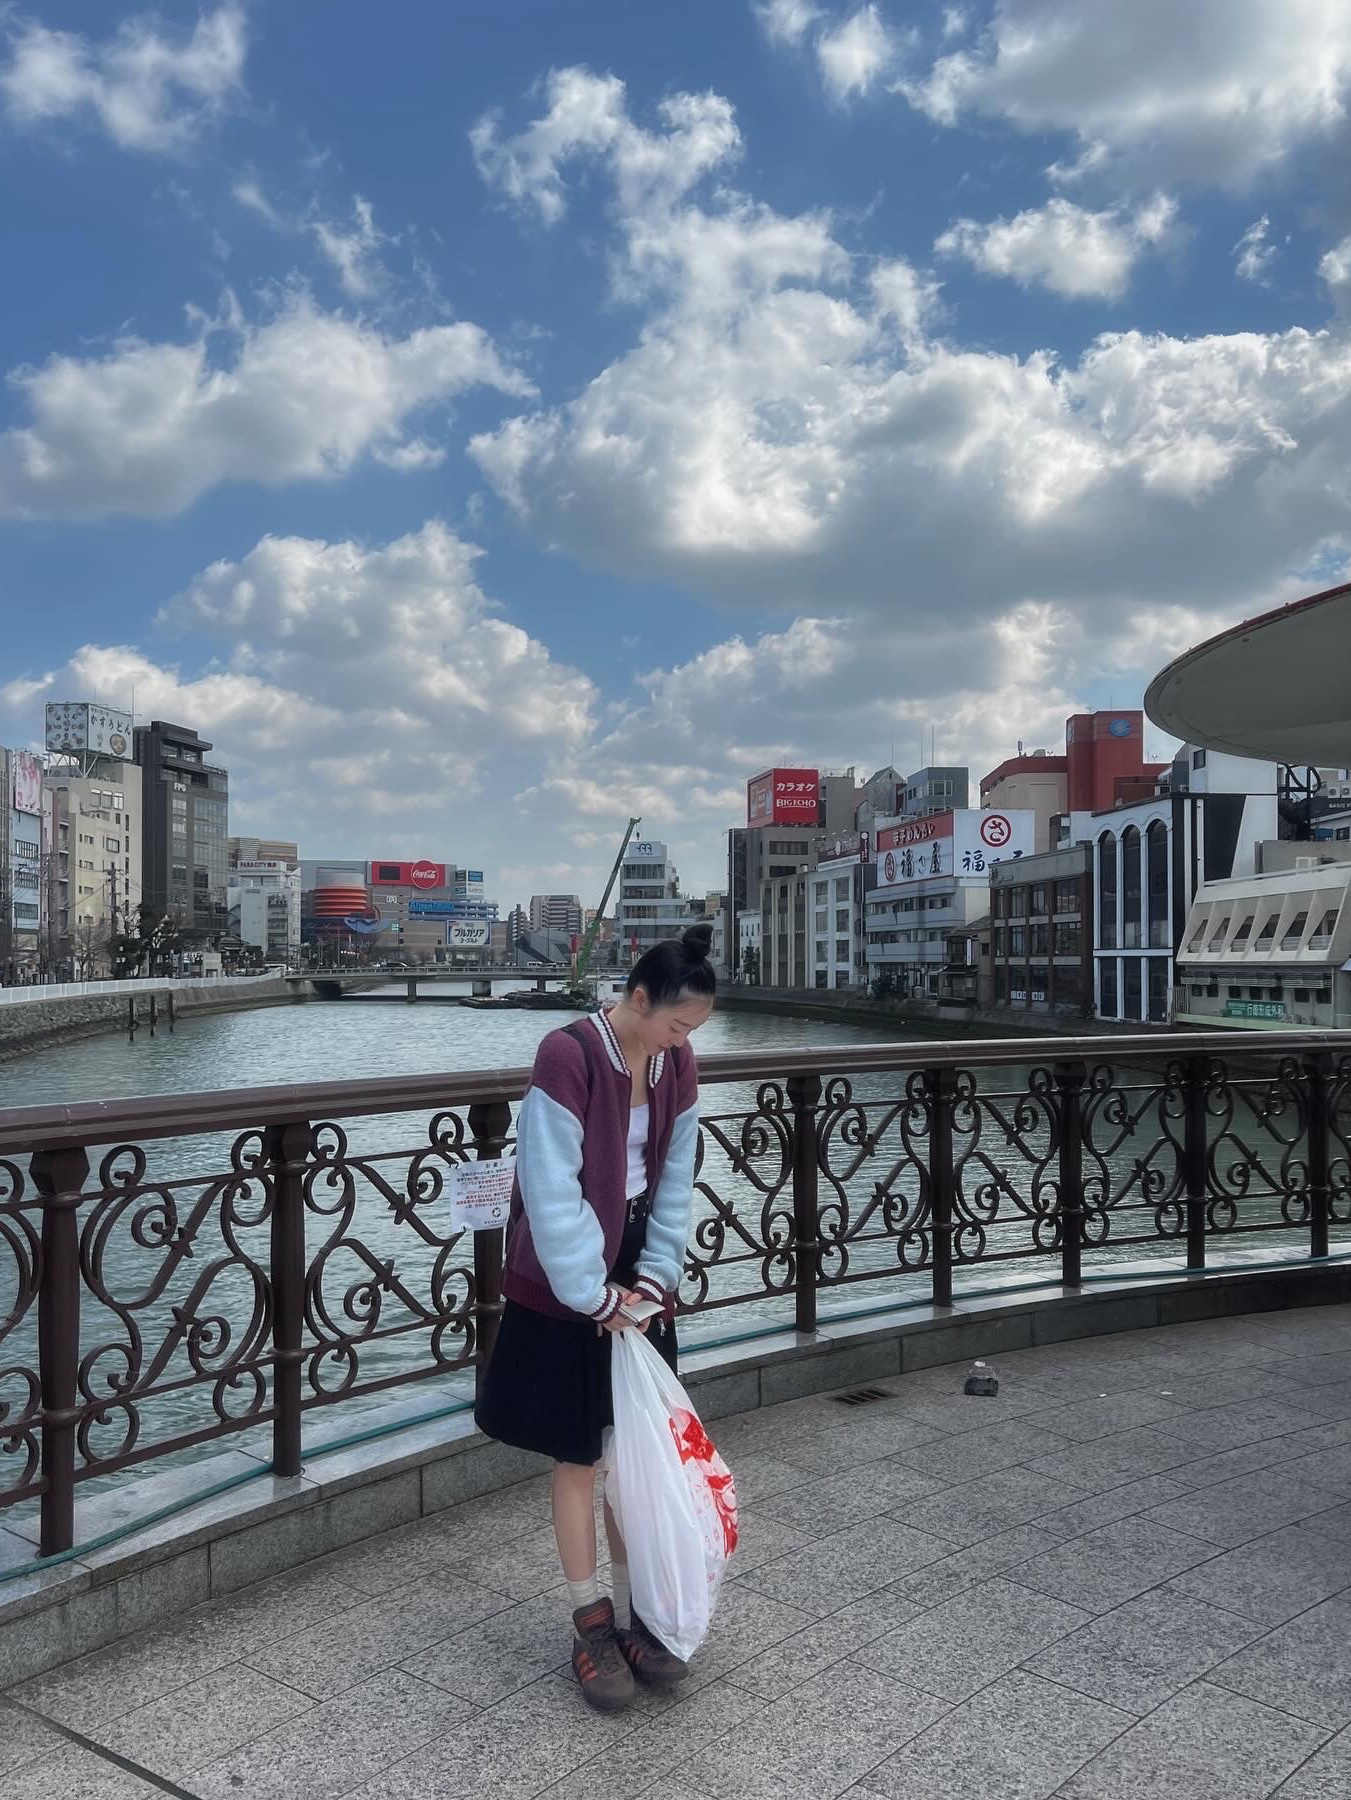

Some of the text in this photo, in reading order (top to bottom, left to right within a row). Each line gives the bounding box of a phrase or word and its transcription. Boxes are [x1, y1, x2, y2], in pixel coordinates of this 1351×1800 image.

[90, 713, 132, 736] かすうどん
[776, 782, 816, 792] カラオケ
[776, 798, 816, 808] BIG ECHO
[900, 840, 943, 878] 福さ屋
[412, 869, 436, 879] Coca-Cola
[454, 927, 485, 938] ブルガリア
